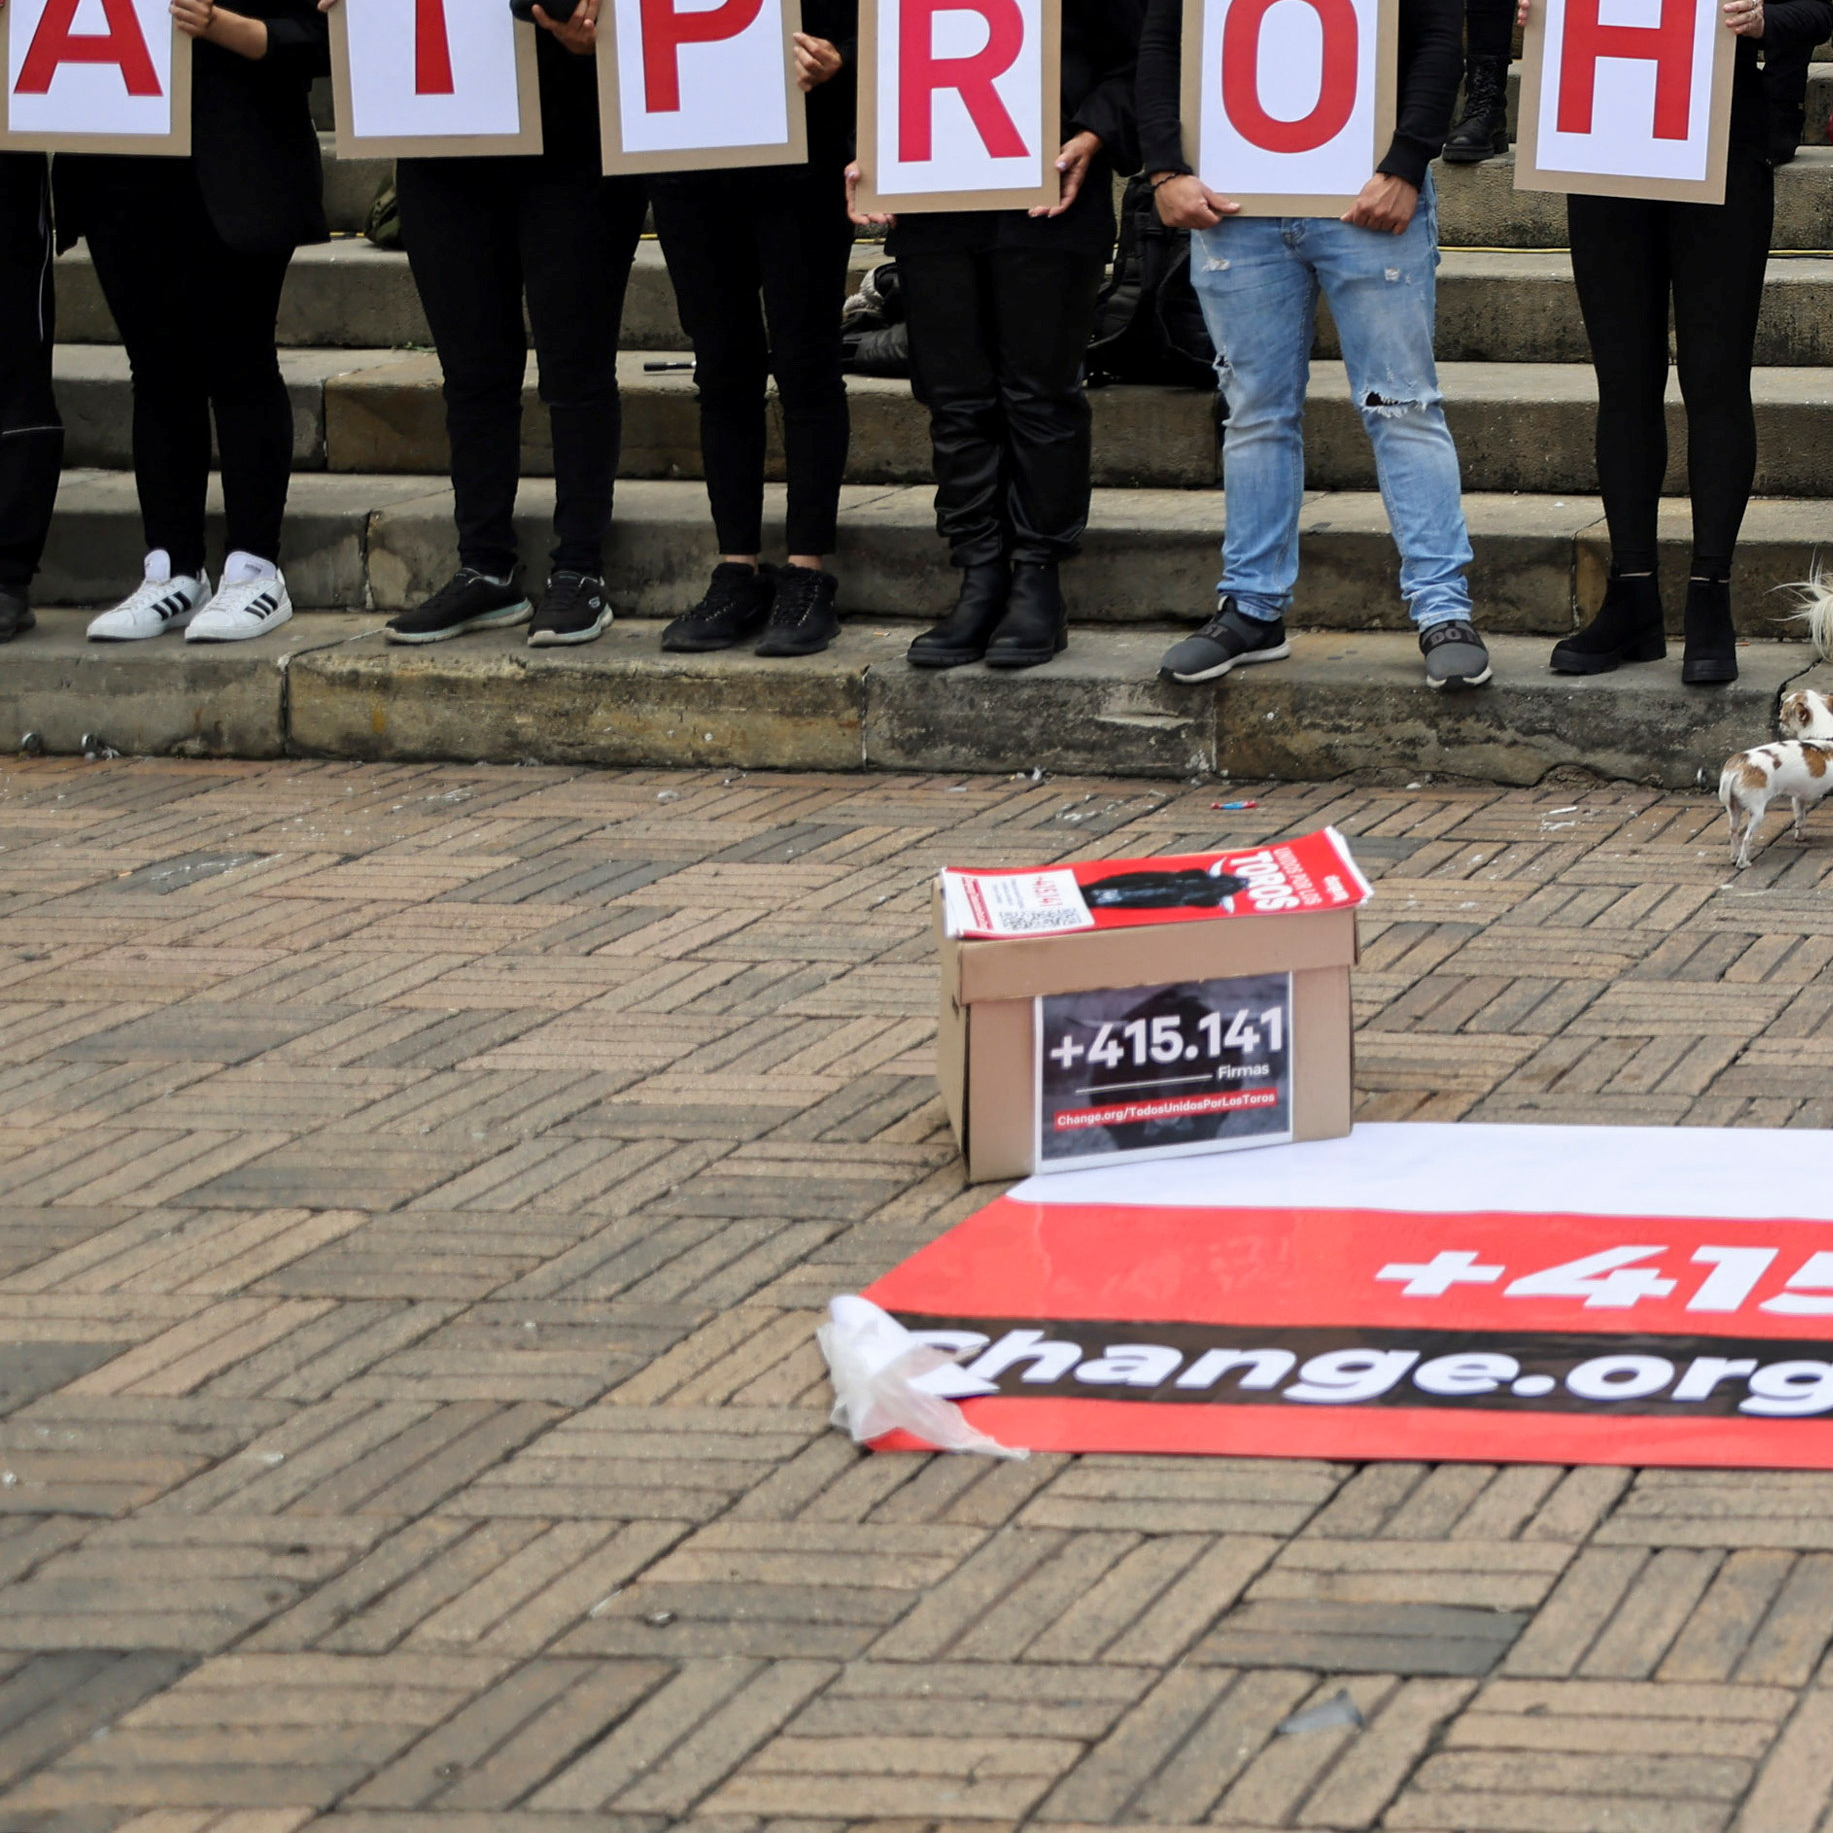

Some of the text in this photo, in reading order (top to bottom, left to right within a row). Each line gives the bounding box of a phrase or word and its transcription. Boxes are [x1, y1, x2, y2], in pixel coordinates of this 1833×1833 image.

[1230, 850, 1300, 912] TOROS
[1050, 1006, 1283, 1069] +415.141
[1217, 1063, 1270, 1082] Firmas
[1056, 1091, 1276, 1128] Change.org/TodosUnidosPorLosToros
